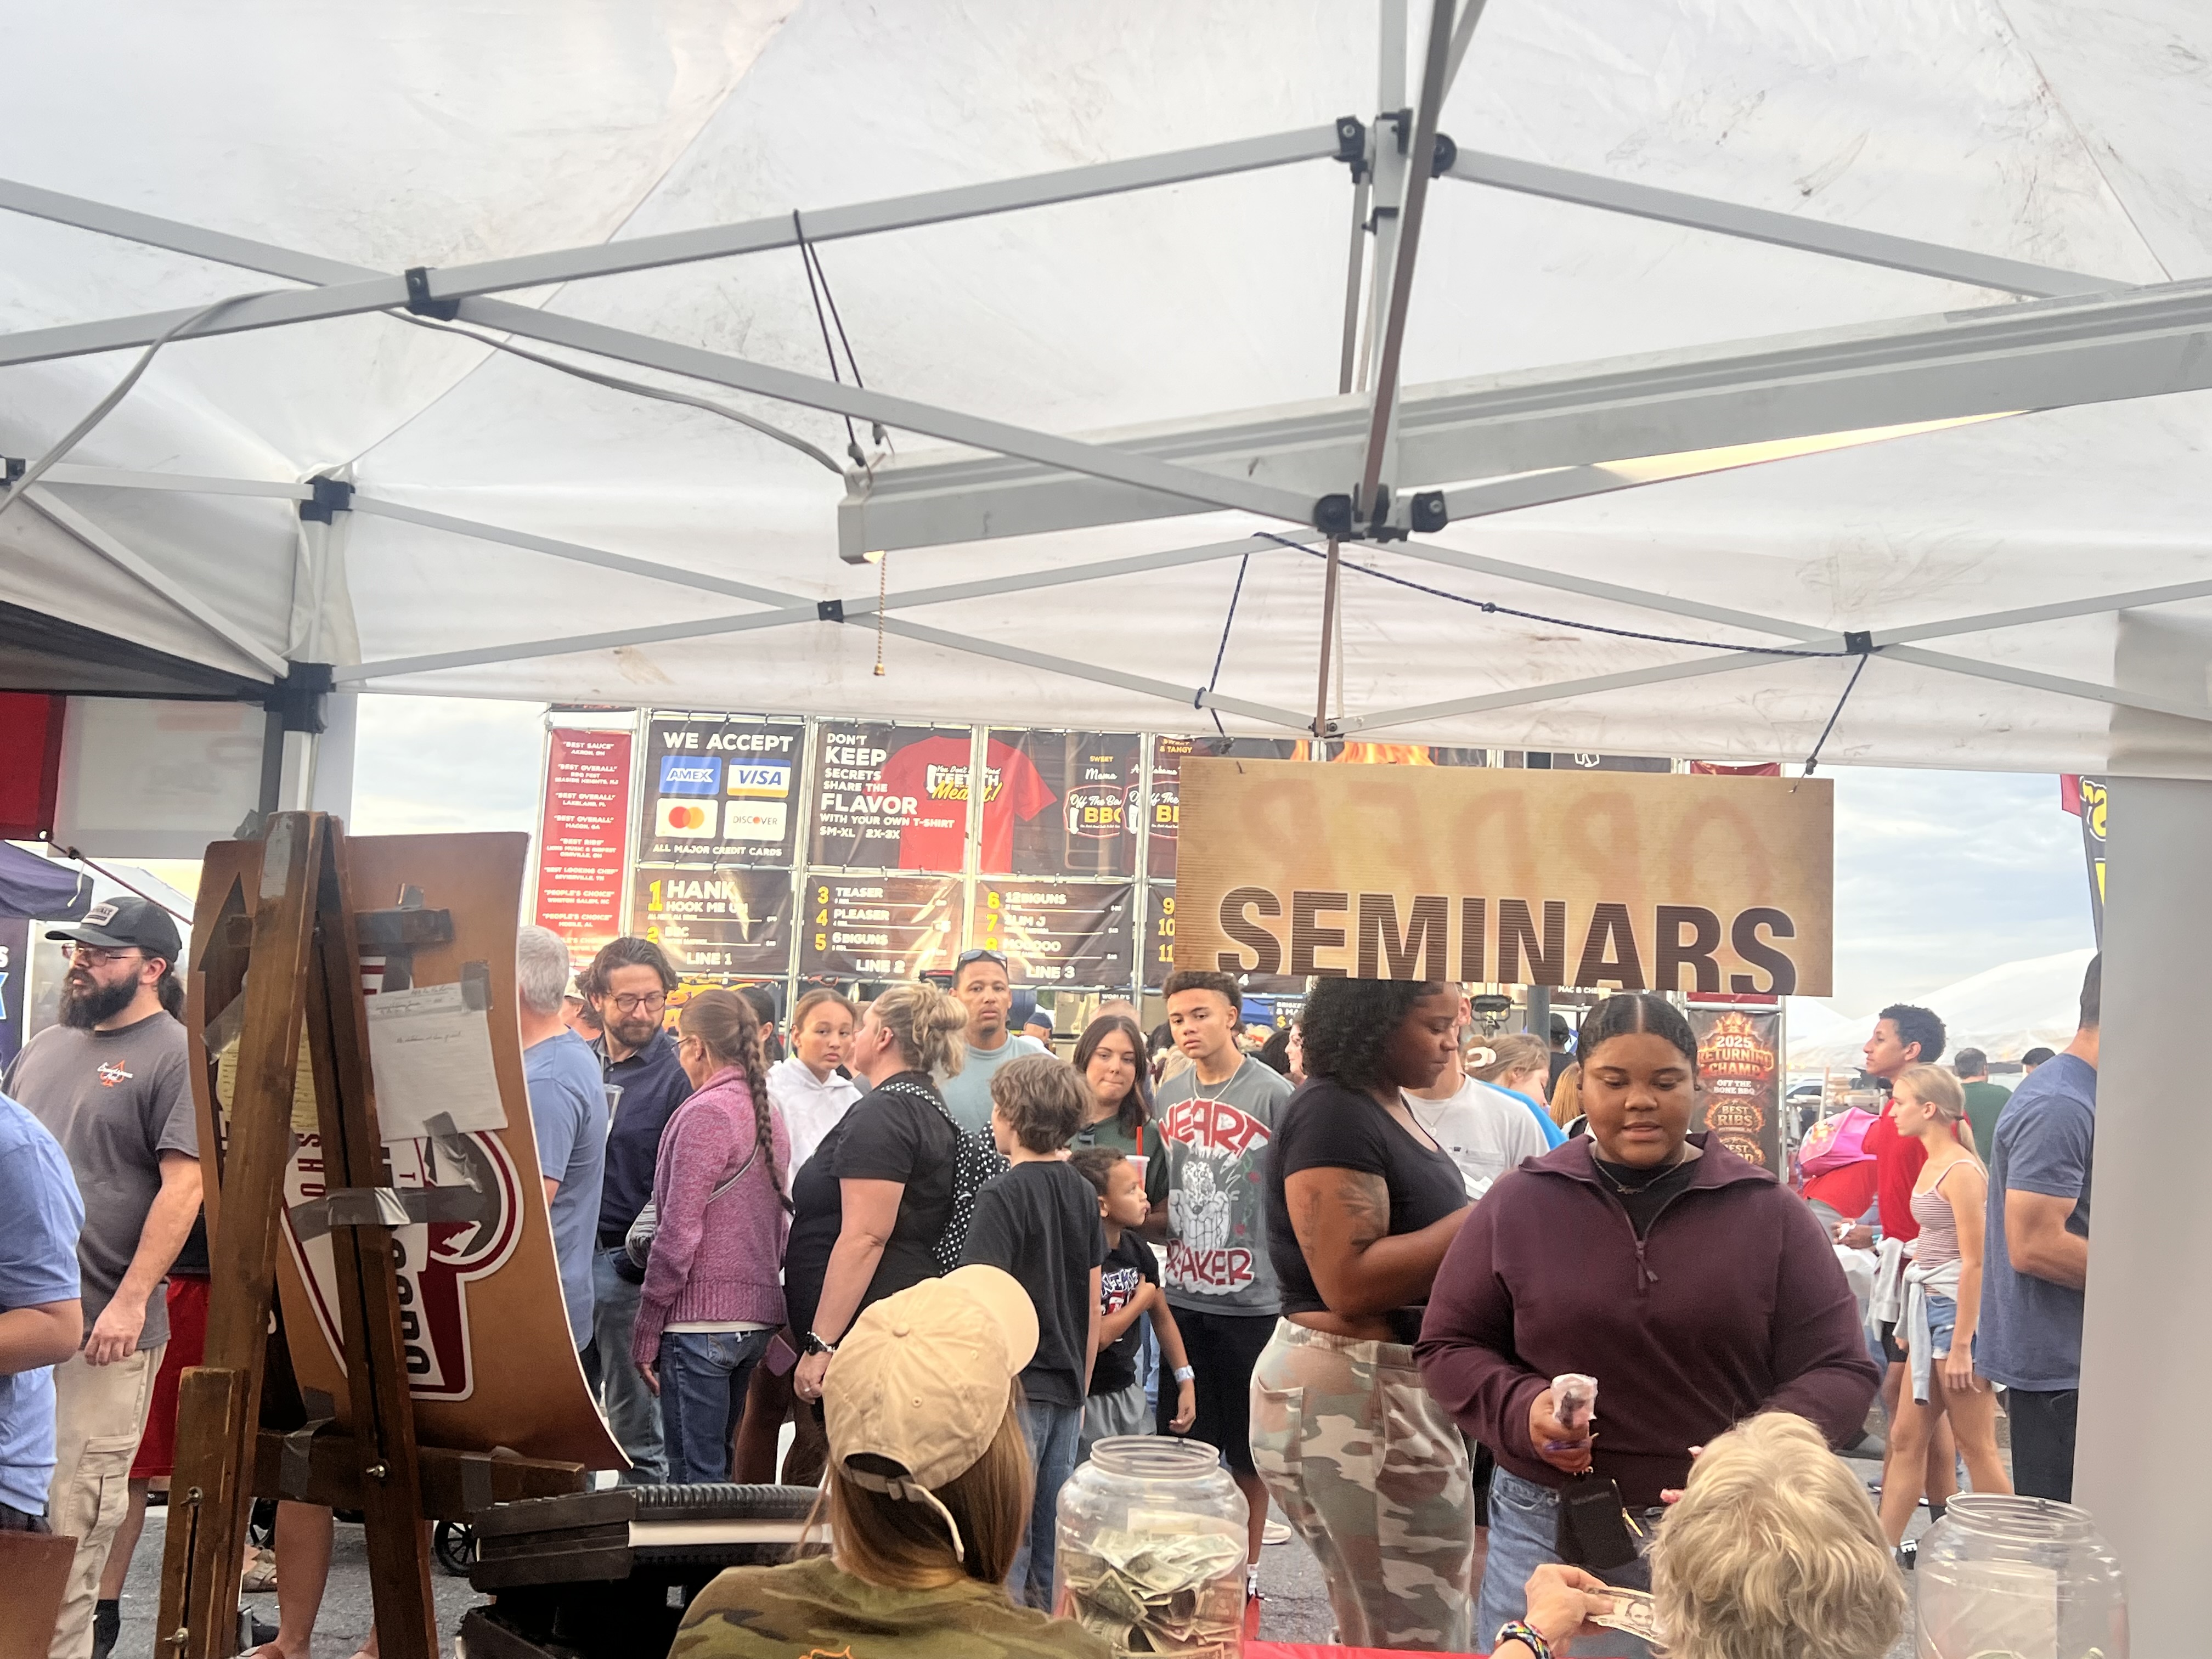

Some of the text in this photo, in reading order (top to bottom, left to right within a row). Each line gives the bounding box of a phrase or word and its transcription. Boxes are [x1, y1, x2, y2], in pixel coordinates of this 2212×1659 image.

[663, 731, 794, 752] WE ACCEPT
[827, 733, 867, 745] DON'T
[825, 746, 888, 766] KEEP
[1167, 746, 1193, 754] TANGY
[668, 769, 713, 782] AMEX
[739, 769, 782, 786] VISA
[825, 767, 882, 781] SECRETS
[1085, 768, 1118, 781] Mama
[823, 780, 888, 793] SHARE THE
[821, 793, 918, 815] FLAVOR
[1070, 794, 1088, 809] Off
[1088, 795, 1106, 806] The
[732, 815, 778, 825] DISCOVER
[820, 813, 955, 828] WITH YOUR OWN T-SHIRT
[820, 825, 901, 839] SM-XL 2X-3X
[653, 844, 782, 856] ALL MAJOR CREDIT CARDS
[648, 879, 663, 912] 1
[817, 885, 830, 905] 3
[835, 887, 884, 898] TEASER
[987, 891, 1001, 910] 6
[666, 901, 704, 913] HOOK
[707, 901, 726, 913] ME
[1163, 897, 1175, 915] 9
[816, 909, 828, 927] 4
[833, 908, 890, 921] PLEASER
[986, 914, 998, 933] 7
[1035, 916, 1046, 928] J
[1158, 918, 1176, 936] 10
[646, 926, 659, 945] 2
[815, 933, 827, 951] 5
[1217, 885, 1798, 1000] SEMINARS
[985, 936, 998, 951] 8
[686, 951, 732, 966] LINE 1
[1158, 944, 1174, 962] 11
[855, 959, 906, 974] LINE 2
[1026, 965, 1076, 979] LINE 3
[1238, 973, 1250, 986] 4
[1557, 985, 1575, 994] MAC
[1716, 1035, 1752, 1048] 2025
[1708, 1062, 1761, 1076] CHAMP
[1722, 1105, 1750, 1114] BEST
[1717, 1114, 1753, 1127] RIBS
[1723, 1144, 1750, 1153] EST
